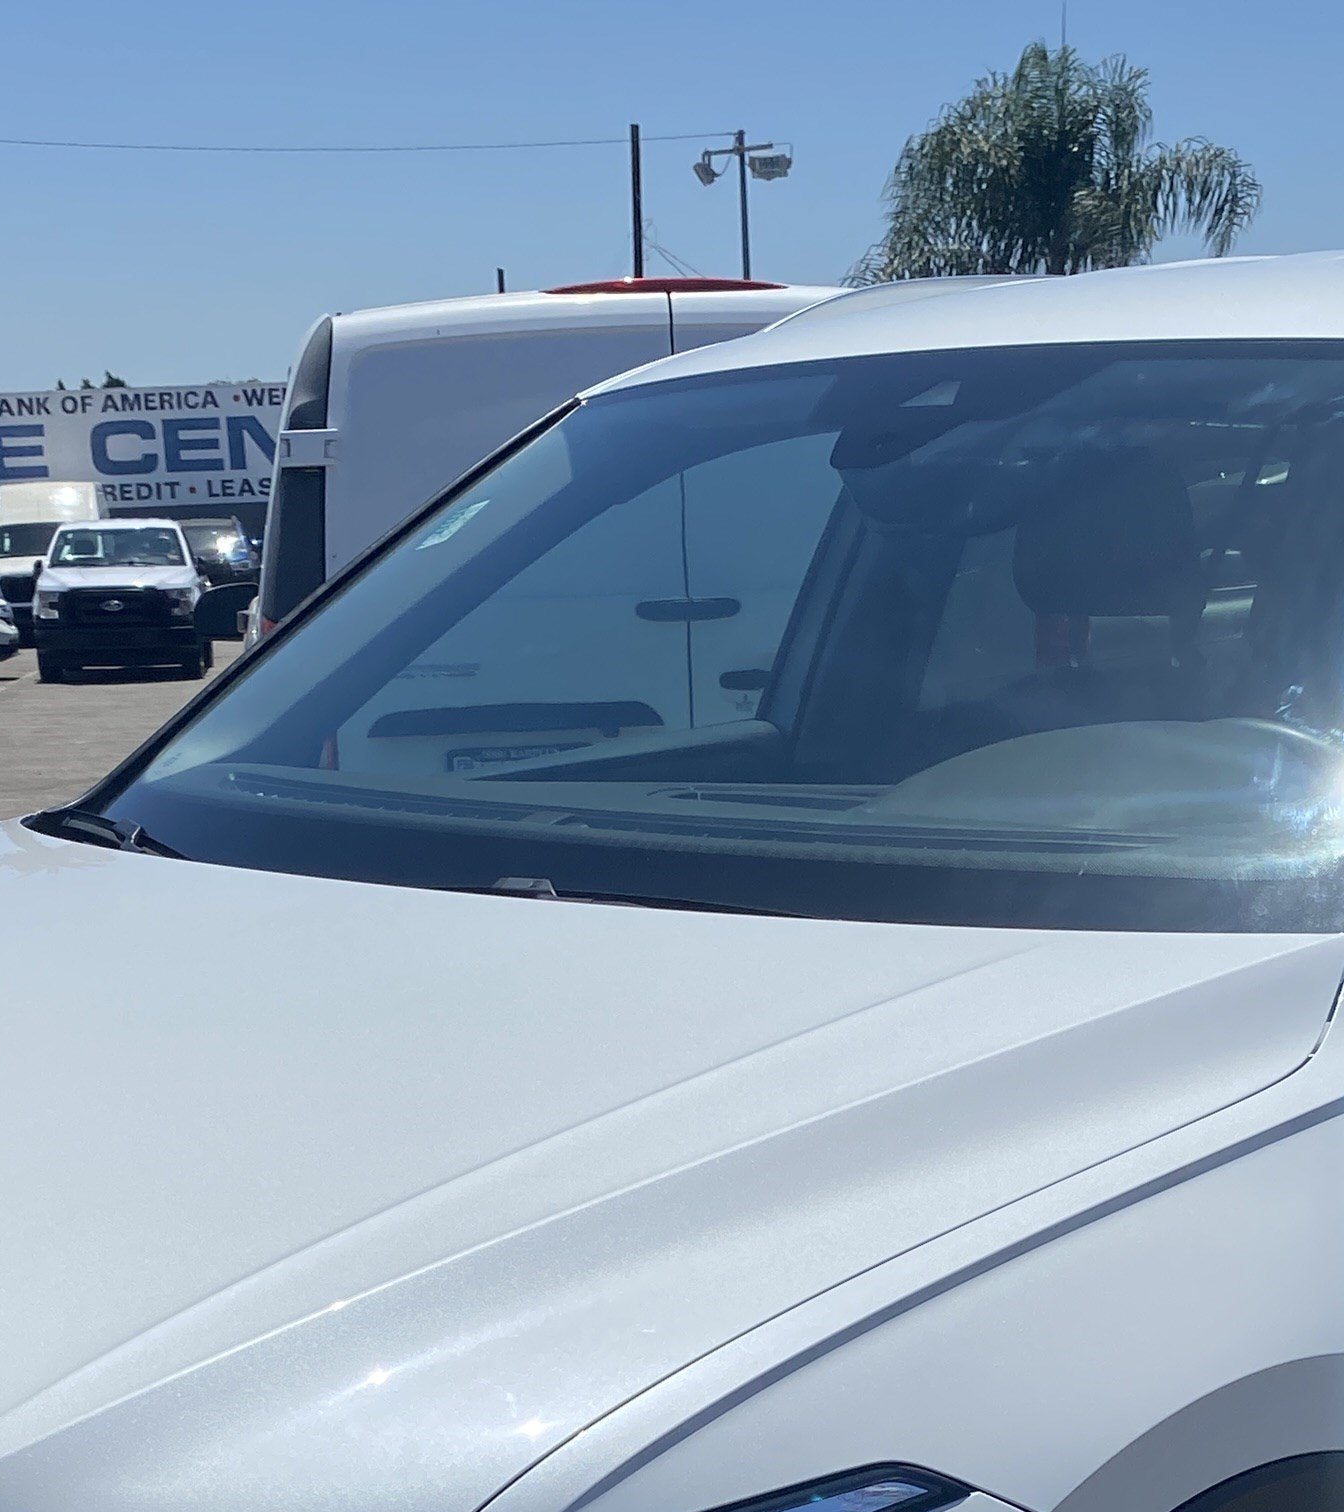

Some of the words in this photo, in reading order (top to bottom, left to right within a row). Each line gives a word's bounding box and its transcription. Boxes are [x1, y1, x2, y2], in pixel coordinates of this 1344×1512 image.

[61, 394, 92, 414] OF
[101, 390, 220, 413] AMERICA
[99, 481, 180, 501] REDIT
